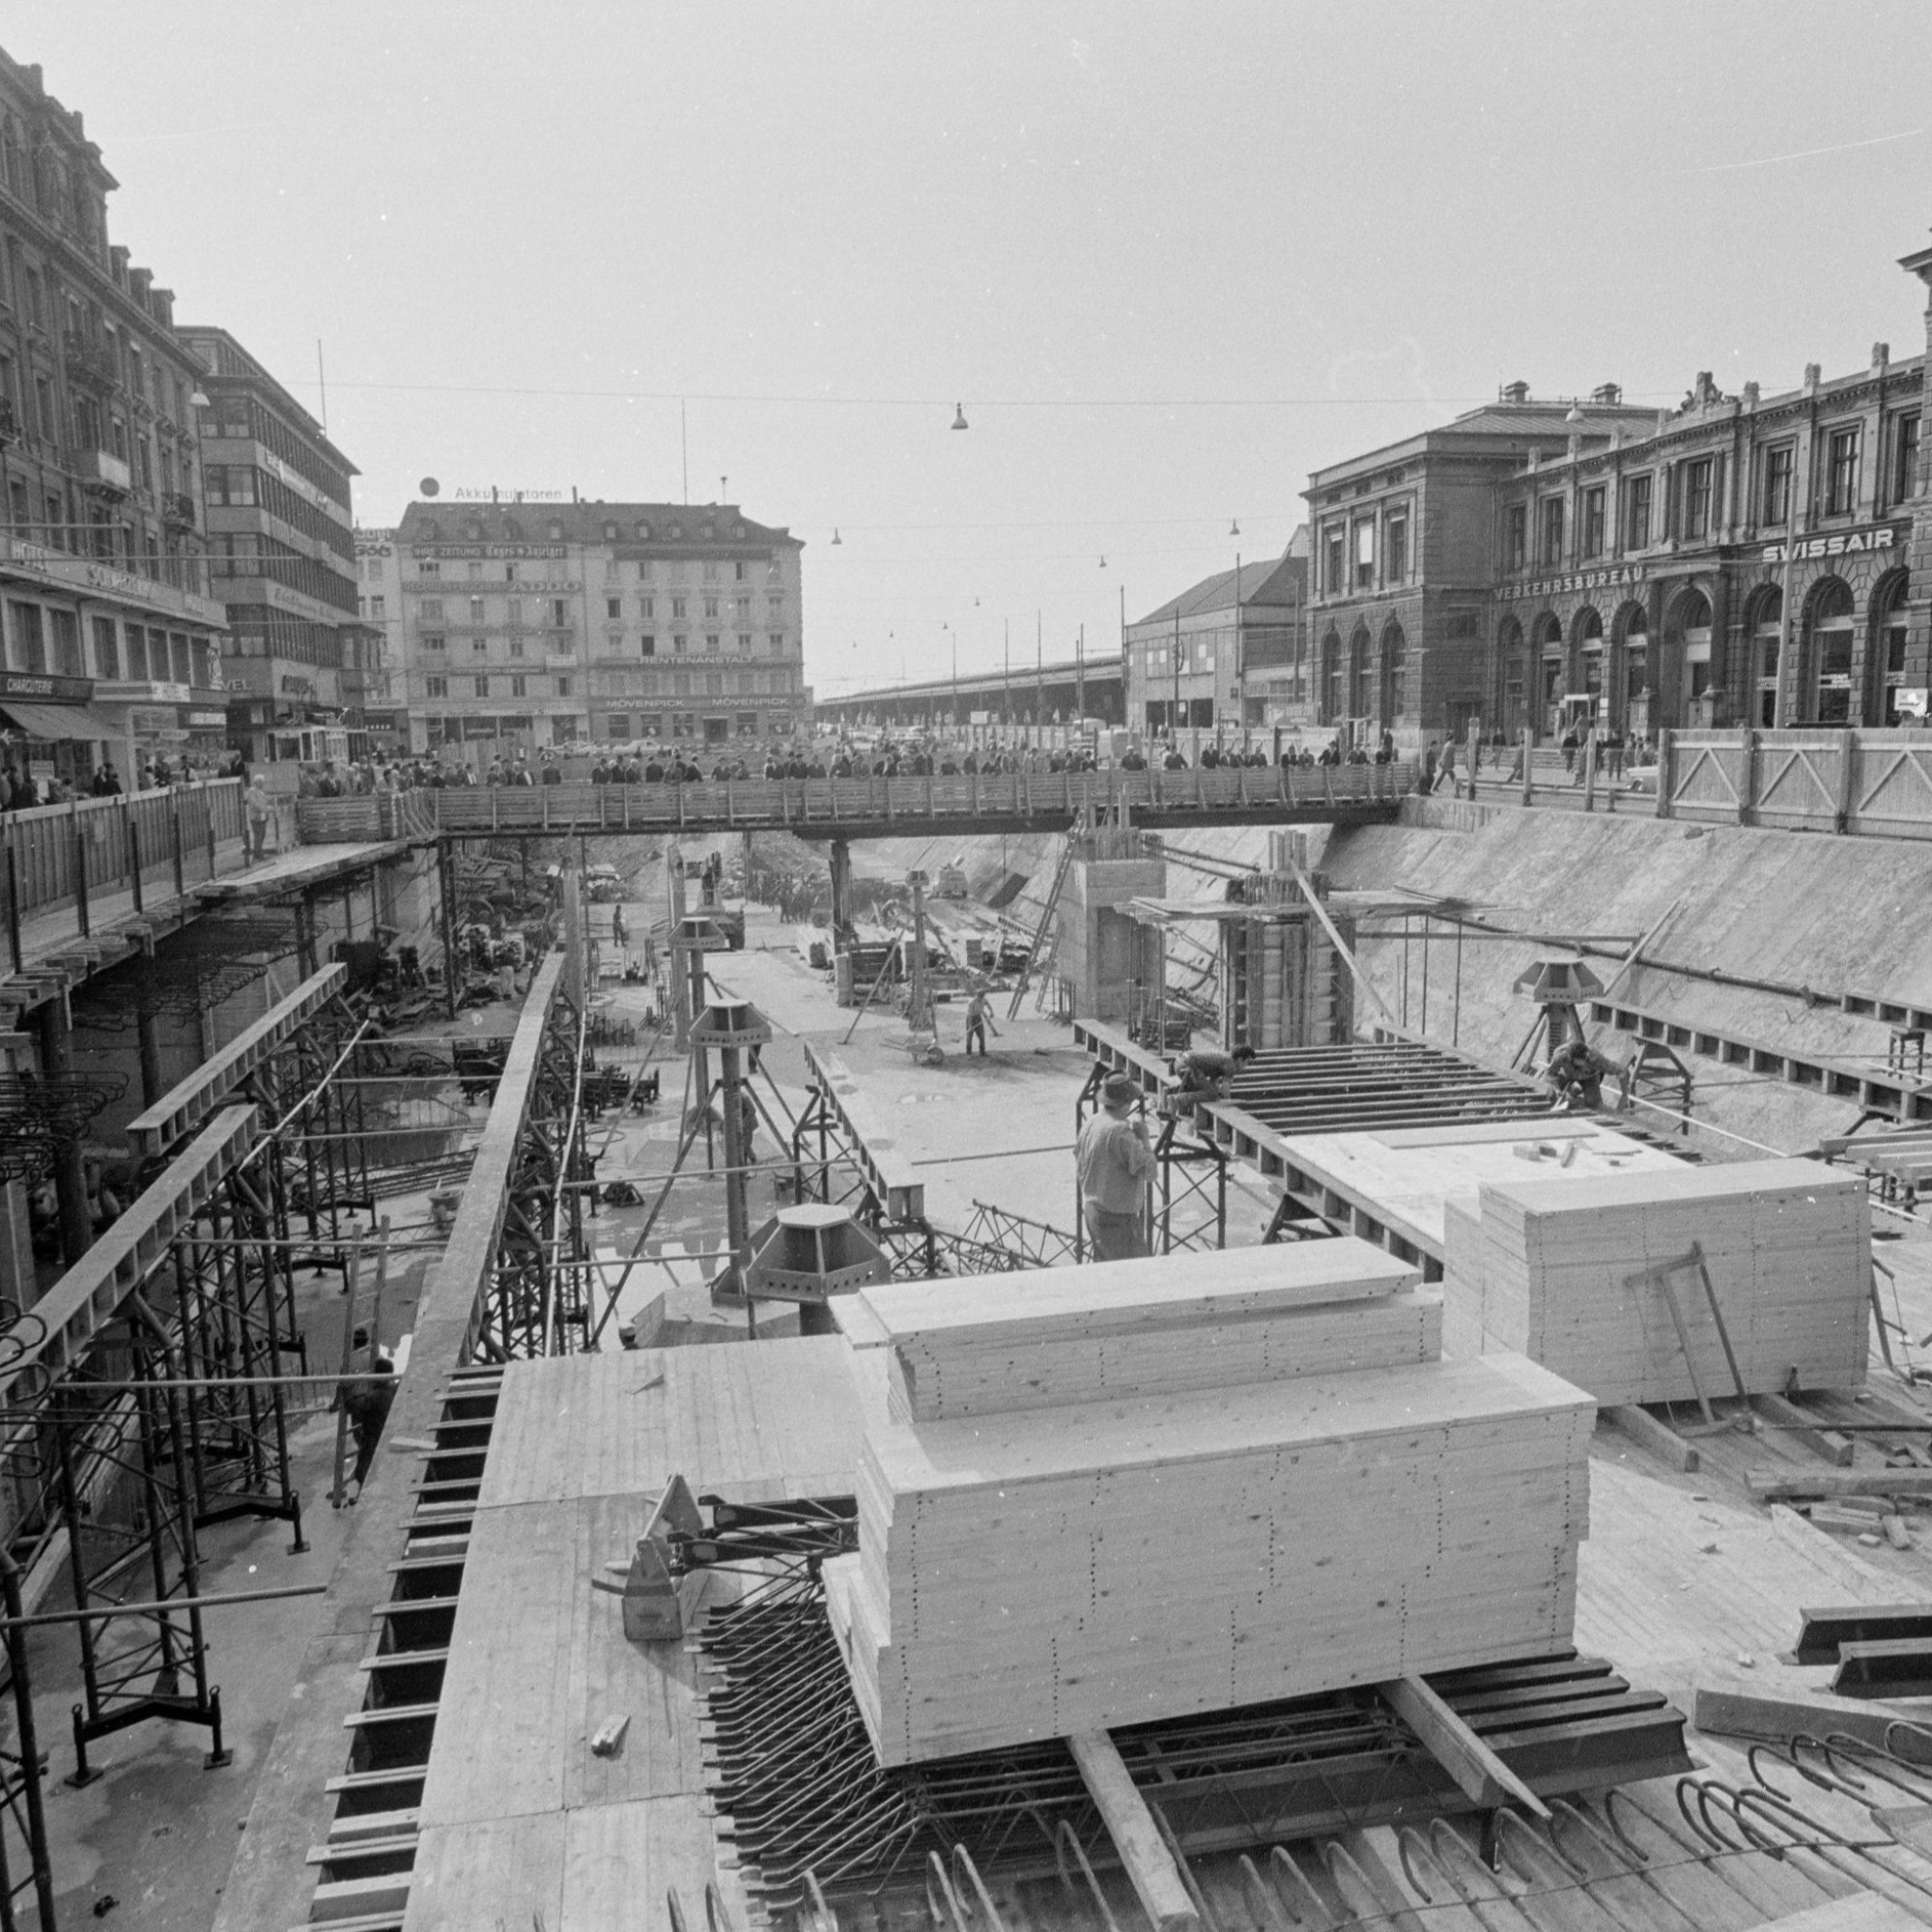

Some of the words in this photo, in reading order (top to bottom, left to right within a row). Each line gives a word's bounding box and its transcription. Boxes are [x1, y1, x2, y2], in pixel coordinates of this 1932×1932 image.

[1762, 528, 1894, 562] SWISSAIR
[1493, 566, 1643, 601] VERKEHRSBUREAU
[639, 656, 754, 665] RENTENANSTALT
[606, 698, 685, 708] MÖVENPICK
[712, 697, 789, 707] MÖVENPICK
